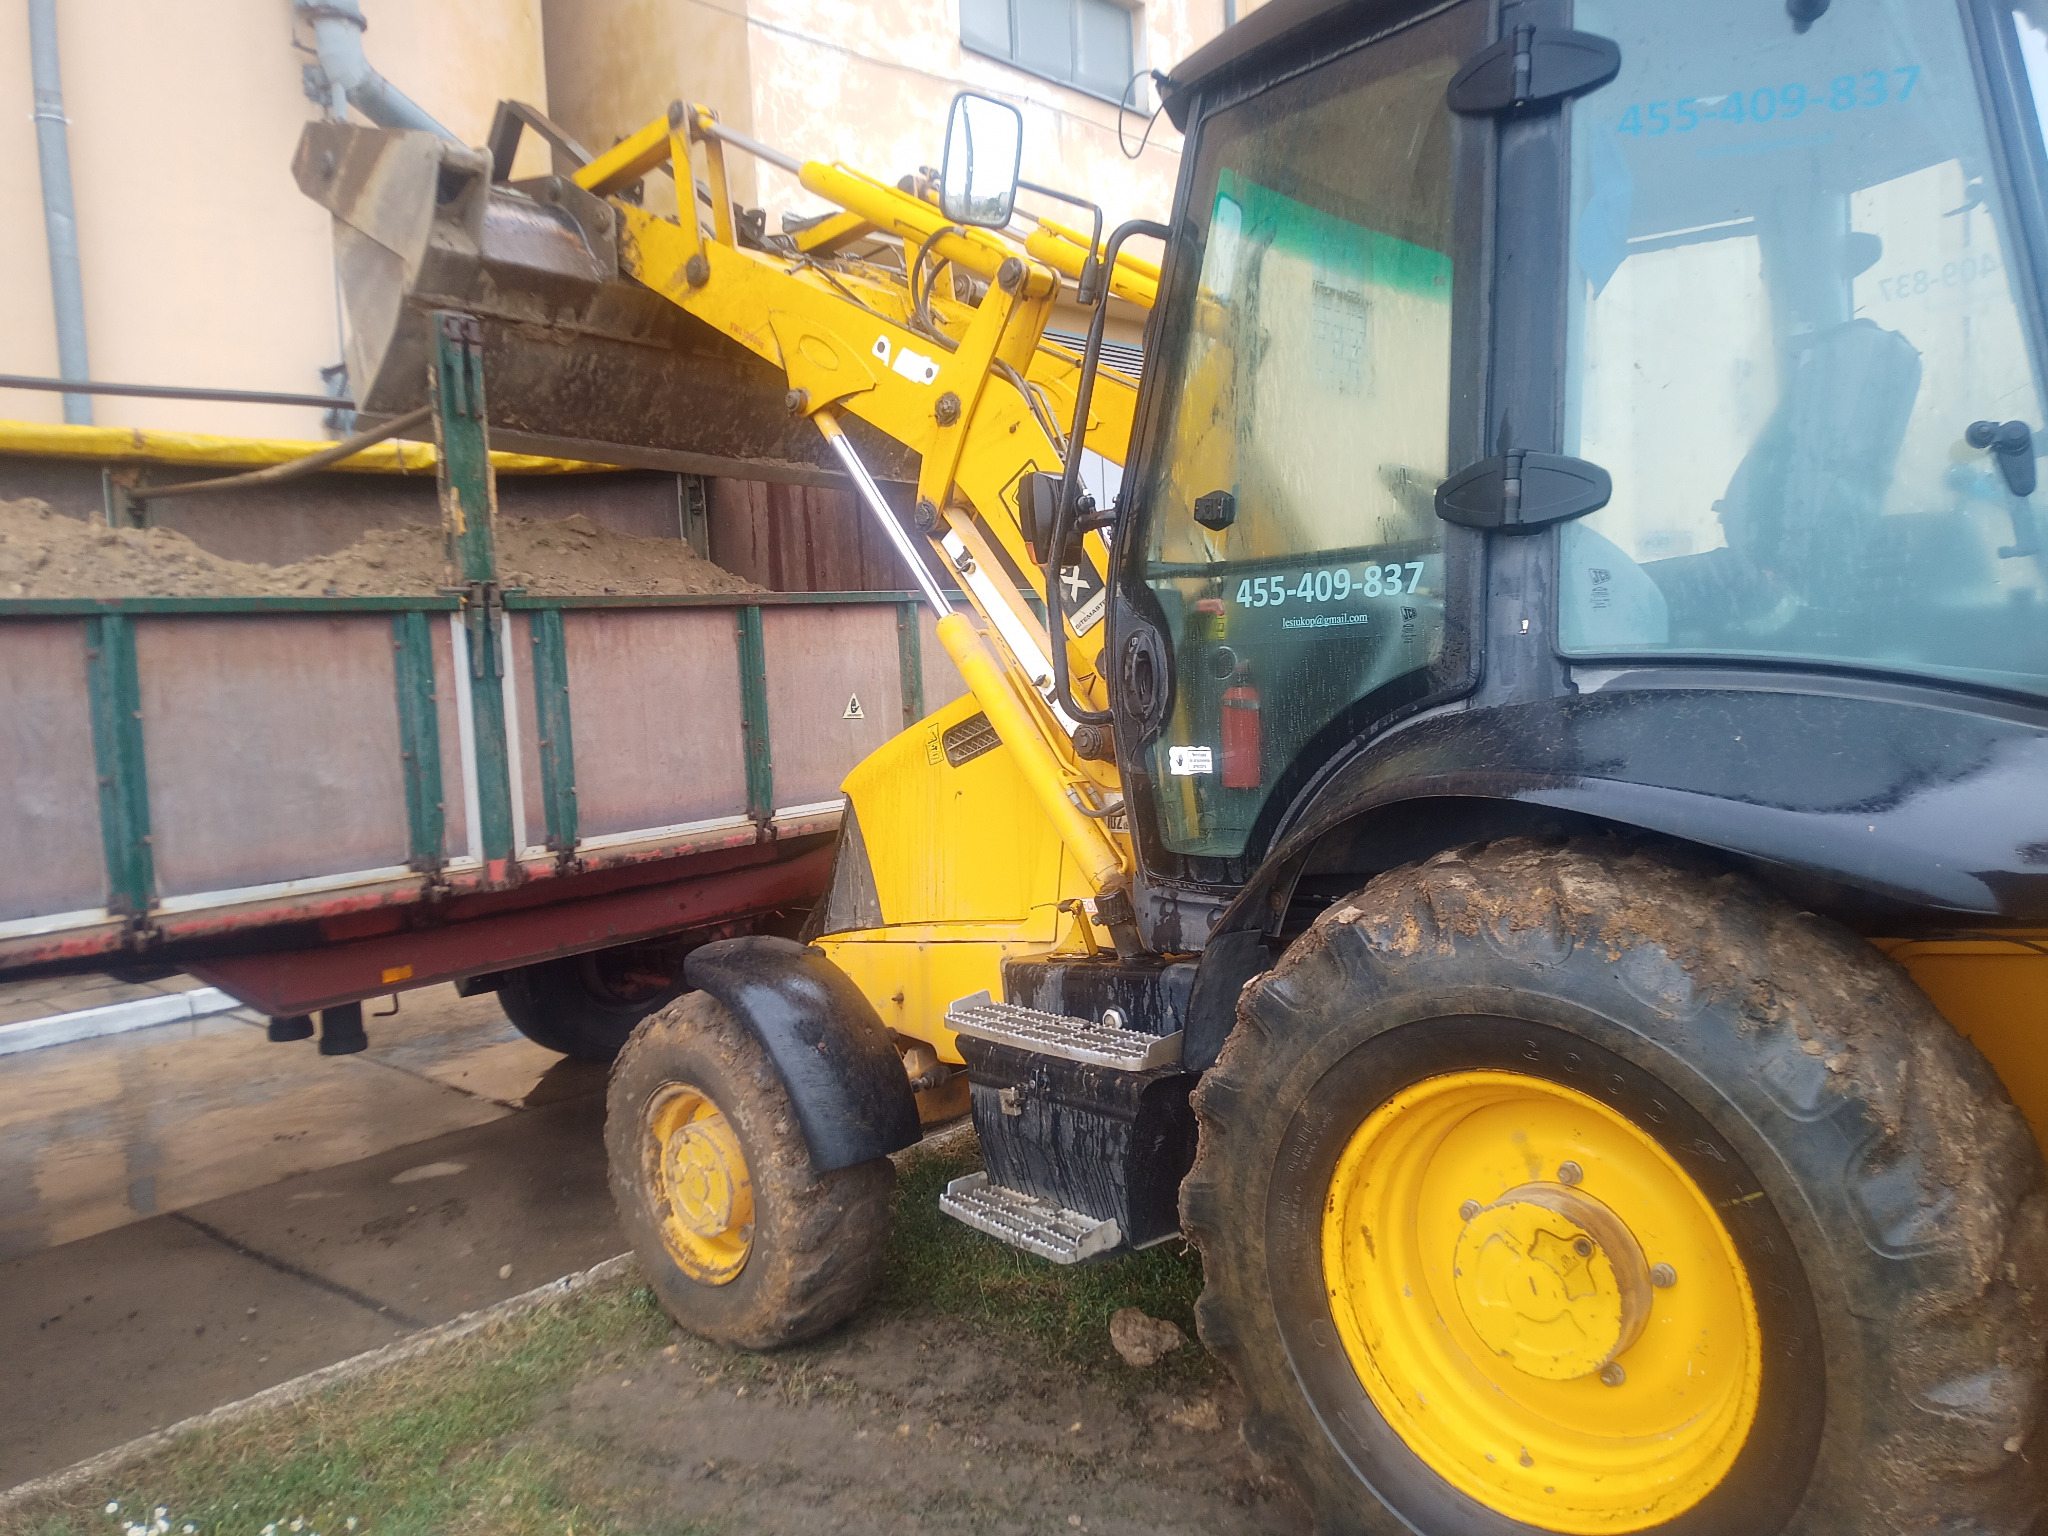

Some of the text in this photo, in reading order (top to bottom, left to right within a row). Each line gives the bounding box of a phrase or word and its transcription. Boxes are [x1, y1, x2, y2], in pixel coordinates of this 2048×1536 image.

[1617, 65, 1921, 137] 455-409-837
[1236, 561, 1425, 608] 455-409-837
[1075, 599, 1106, 630] SITEMAST
[1282, 613, 1369, 629] lesiukop@gmail.com
